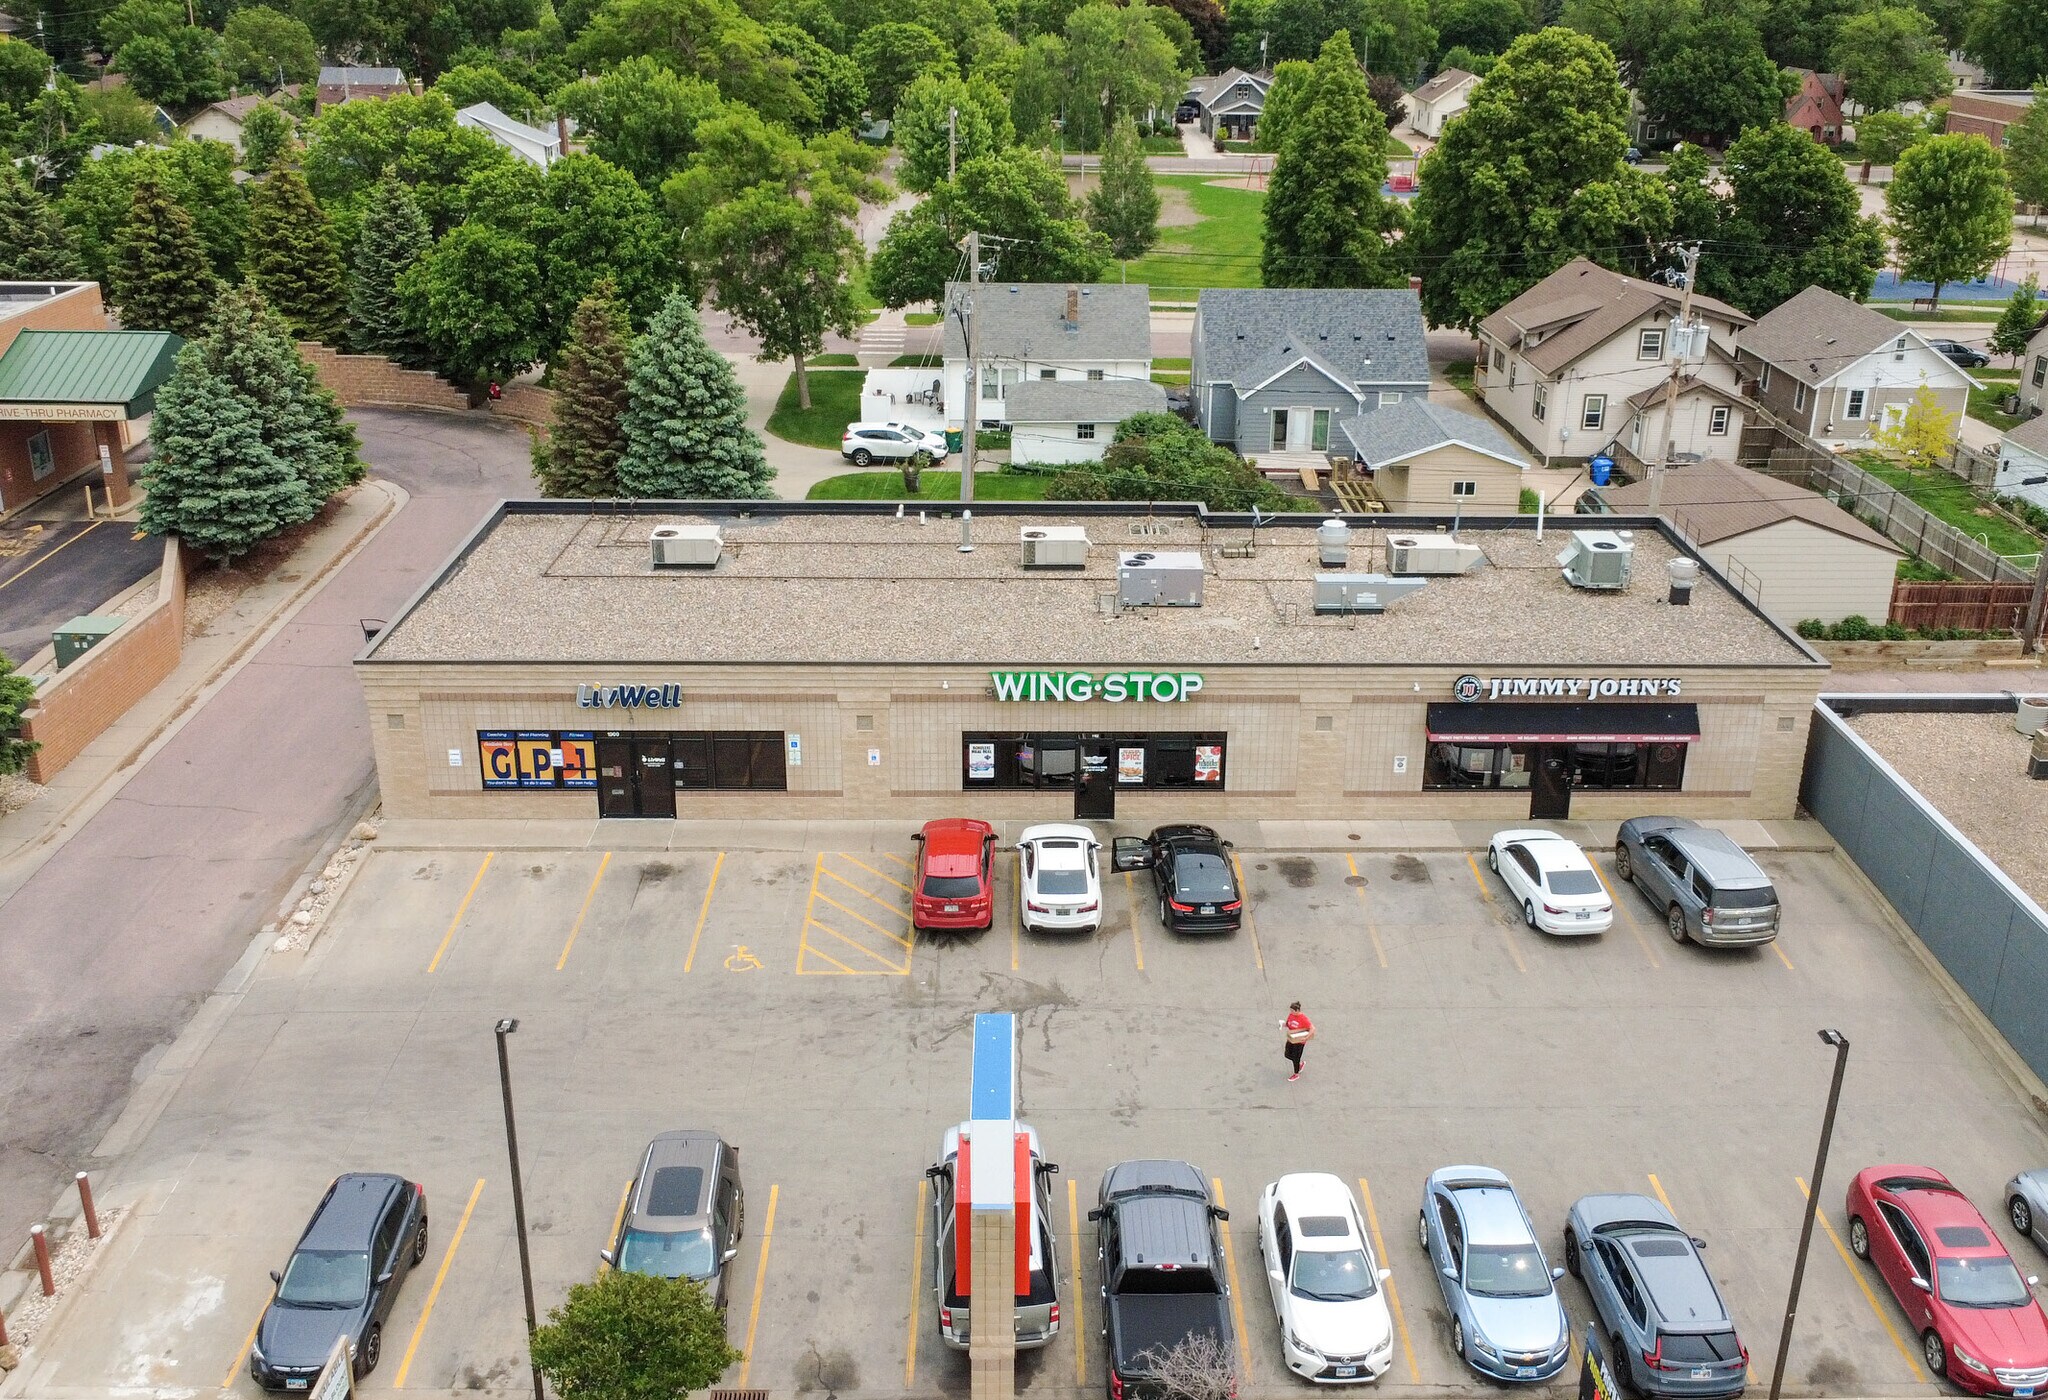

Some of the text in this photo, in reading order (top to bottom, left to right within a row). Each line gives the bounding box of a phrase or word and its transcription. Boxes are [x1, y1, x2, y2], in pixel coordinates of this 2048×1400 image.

[56, 409, 118, 419] PHARMACY
[576, 682, 682, 709] LivWell
[1488, 678, 1583, 701] JIMMY
[1588, 678, 1682, 701] JOHN'S
